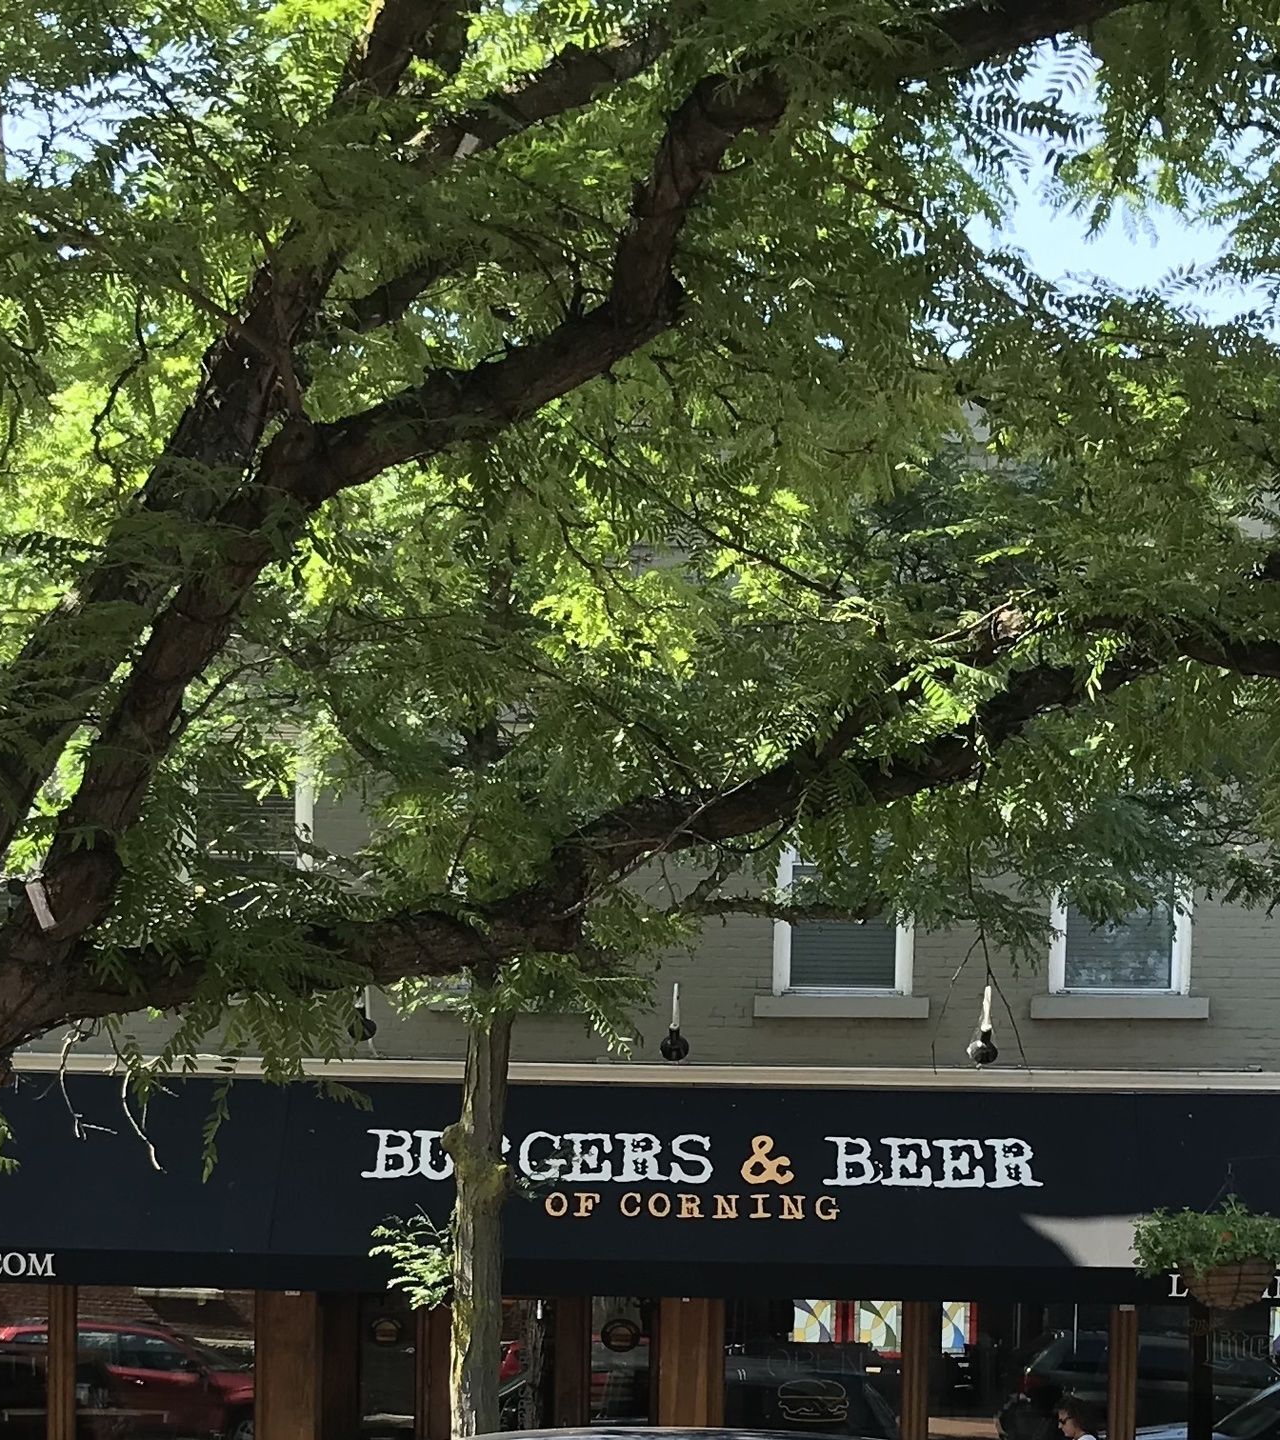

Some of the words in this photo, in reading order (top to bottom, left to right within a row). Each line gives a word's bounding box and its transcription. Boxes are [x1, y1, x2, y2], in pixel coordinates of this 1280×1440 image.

[361, 1129, 713, 1185] BUGERS
[741, 1135, 795, 1185] &
[823, 1136, 1043, 1189] BEER
[545, 1191, 601, 1218] OF
[621, 1192, 841, 1221] CORNING
